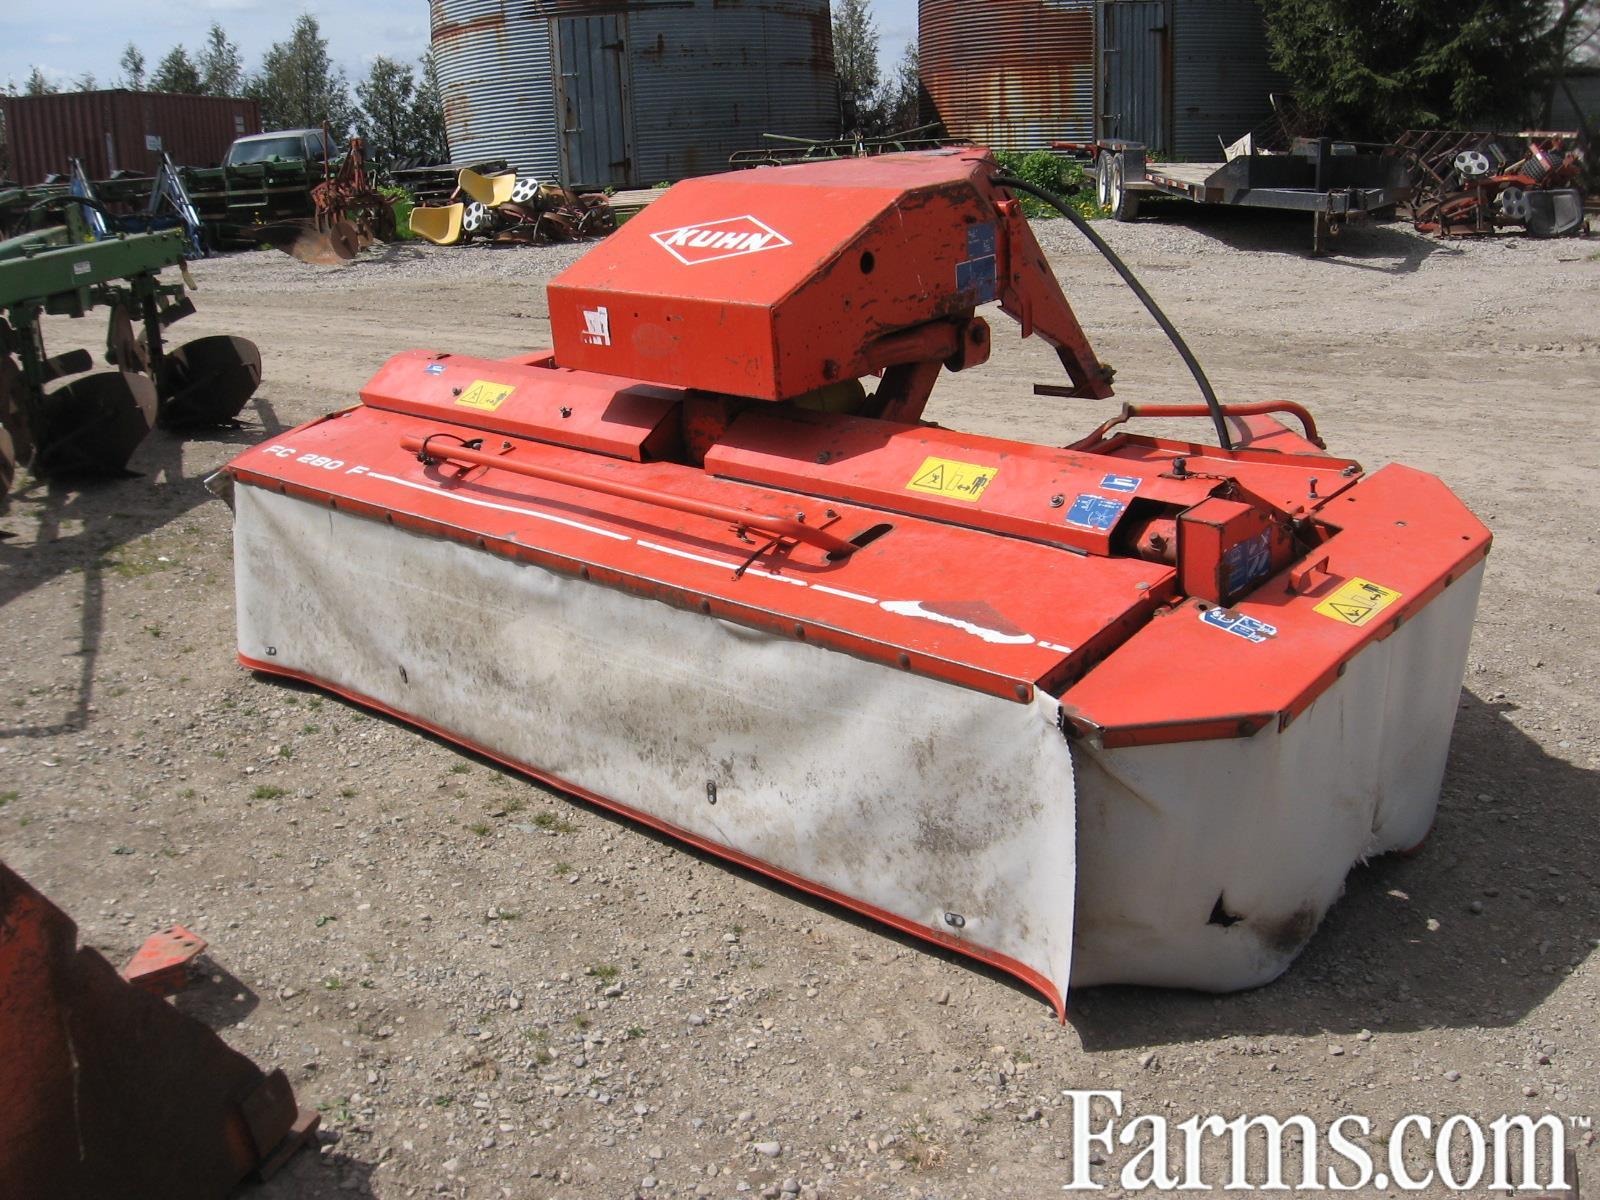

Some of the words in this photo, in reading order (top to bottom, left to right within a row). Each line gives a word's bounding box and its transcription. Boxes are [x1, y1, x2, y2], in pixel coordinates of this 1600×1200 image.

[665, 228, 774, 250] KUHN
[262, 445, 297, 457] FC
[296, 453, 344, 470] 280
[345, 465, 371, 474] F
